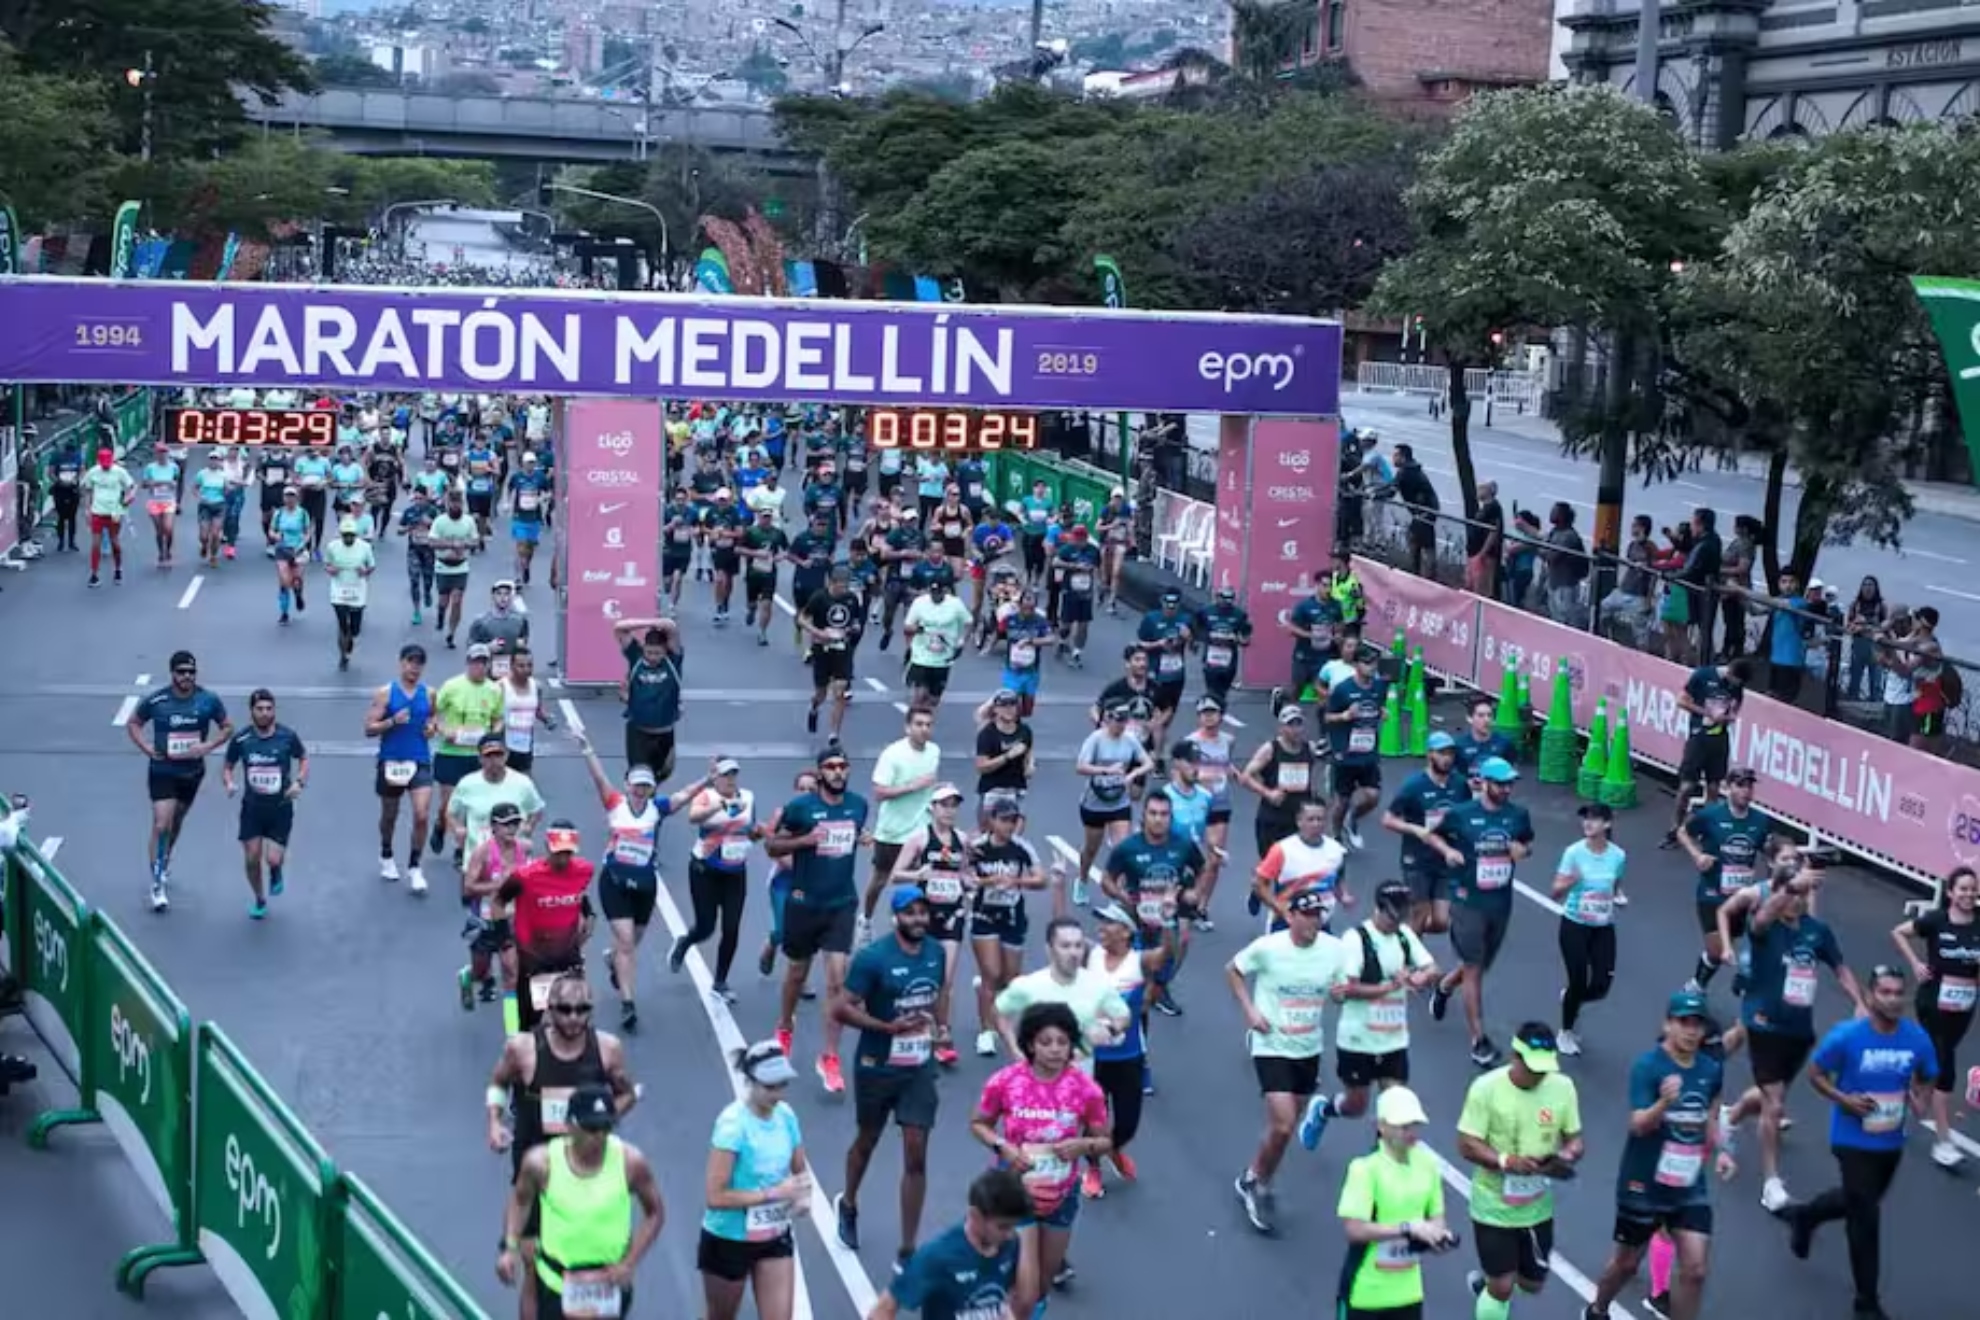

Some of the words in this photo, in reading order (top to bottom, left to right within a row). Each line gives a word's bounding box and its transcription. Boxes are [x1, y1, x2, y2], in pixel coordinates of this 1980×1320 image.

[76, 324, 142, 348] 1994
[171, 297, 580, 382] MARATÓN
[614, 314, 1015, 396] MEDELLÍN
[1038, 352, 1098, 374] 2019
[1198, 351, 1295, 393] epm
[177, 411, 333, 445] 0:03:29
[1627, 676, 1742, 763] MARAN
[1748, 722, 1893, 823] MEDELLÍN
[33, 909, 68, 994] epm
[110, 1003, 150, 1106] epm
[225, 1132, 281, 1260] epm
